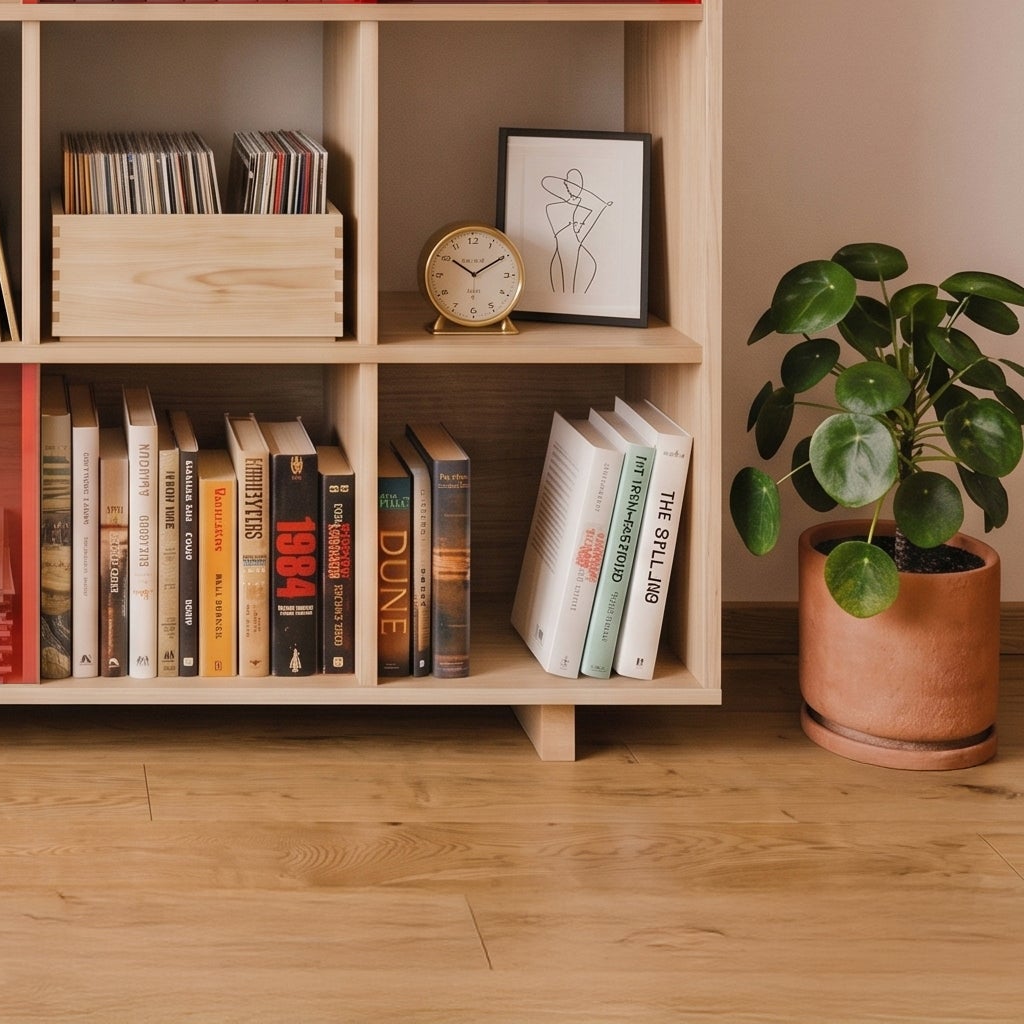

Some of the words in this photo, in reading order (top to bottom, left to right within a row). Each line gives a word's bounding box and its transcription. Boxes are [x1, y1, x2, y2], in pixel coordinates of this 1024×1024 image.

[657, 490, 676, 522] THE
[276, 516, 316, 599] 1984
[379, 530, 408, 636] DUNE
